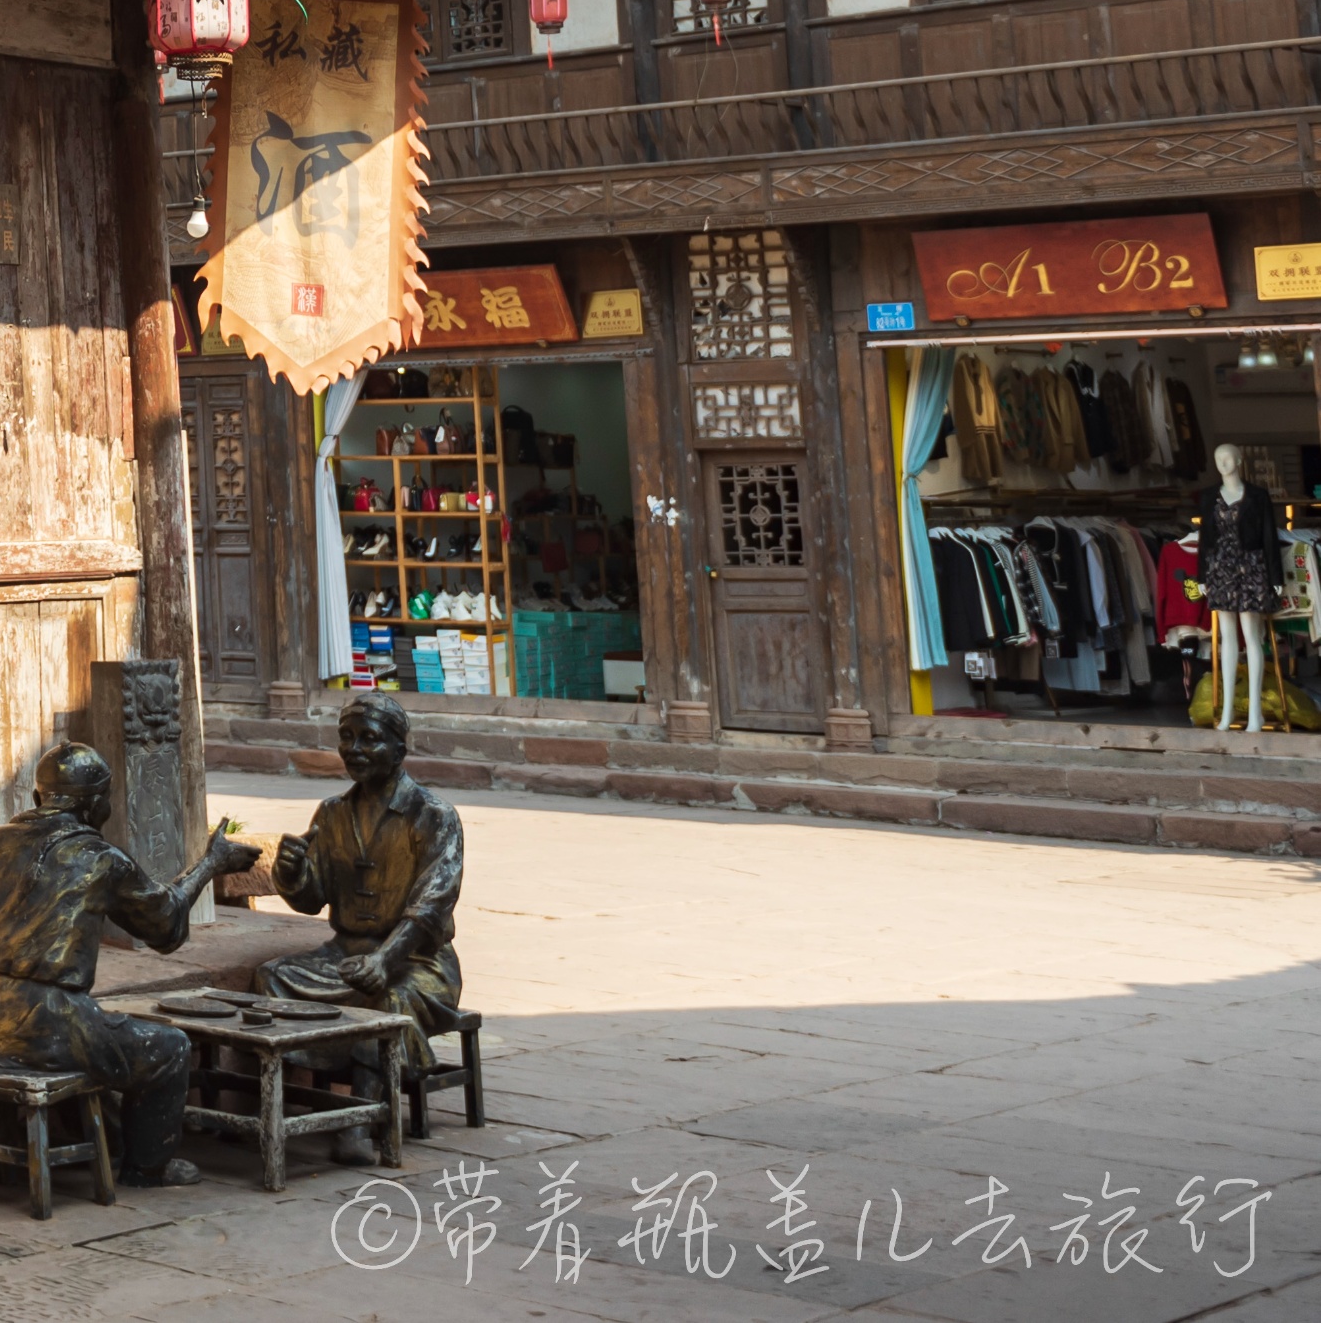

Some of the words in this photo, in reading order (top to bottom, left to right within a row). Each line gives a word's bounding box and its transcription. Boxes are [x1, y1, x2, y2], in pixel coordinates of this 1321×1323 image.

[258, 21, 368, 82] 私藏
[251, 110, 372, 250] 酒
[946, 246, 1056, 300] A1
[1092, 238, 1195, 293] B2
[423, 285, 531, 332] 永福
